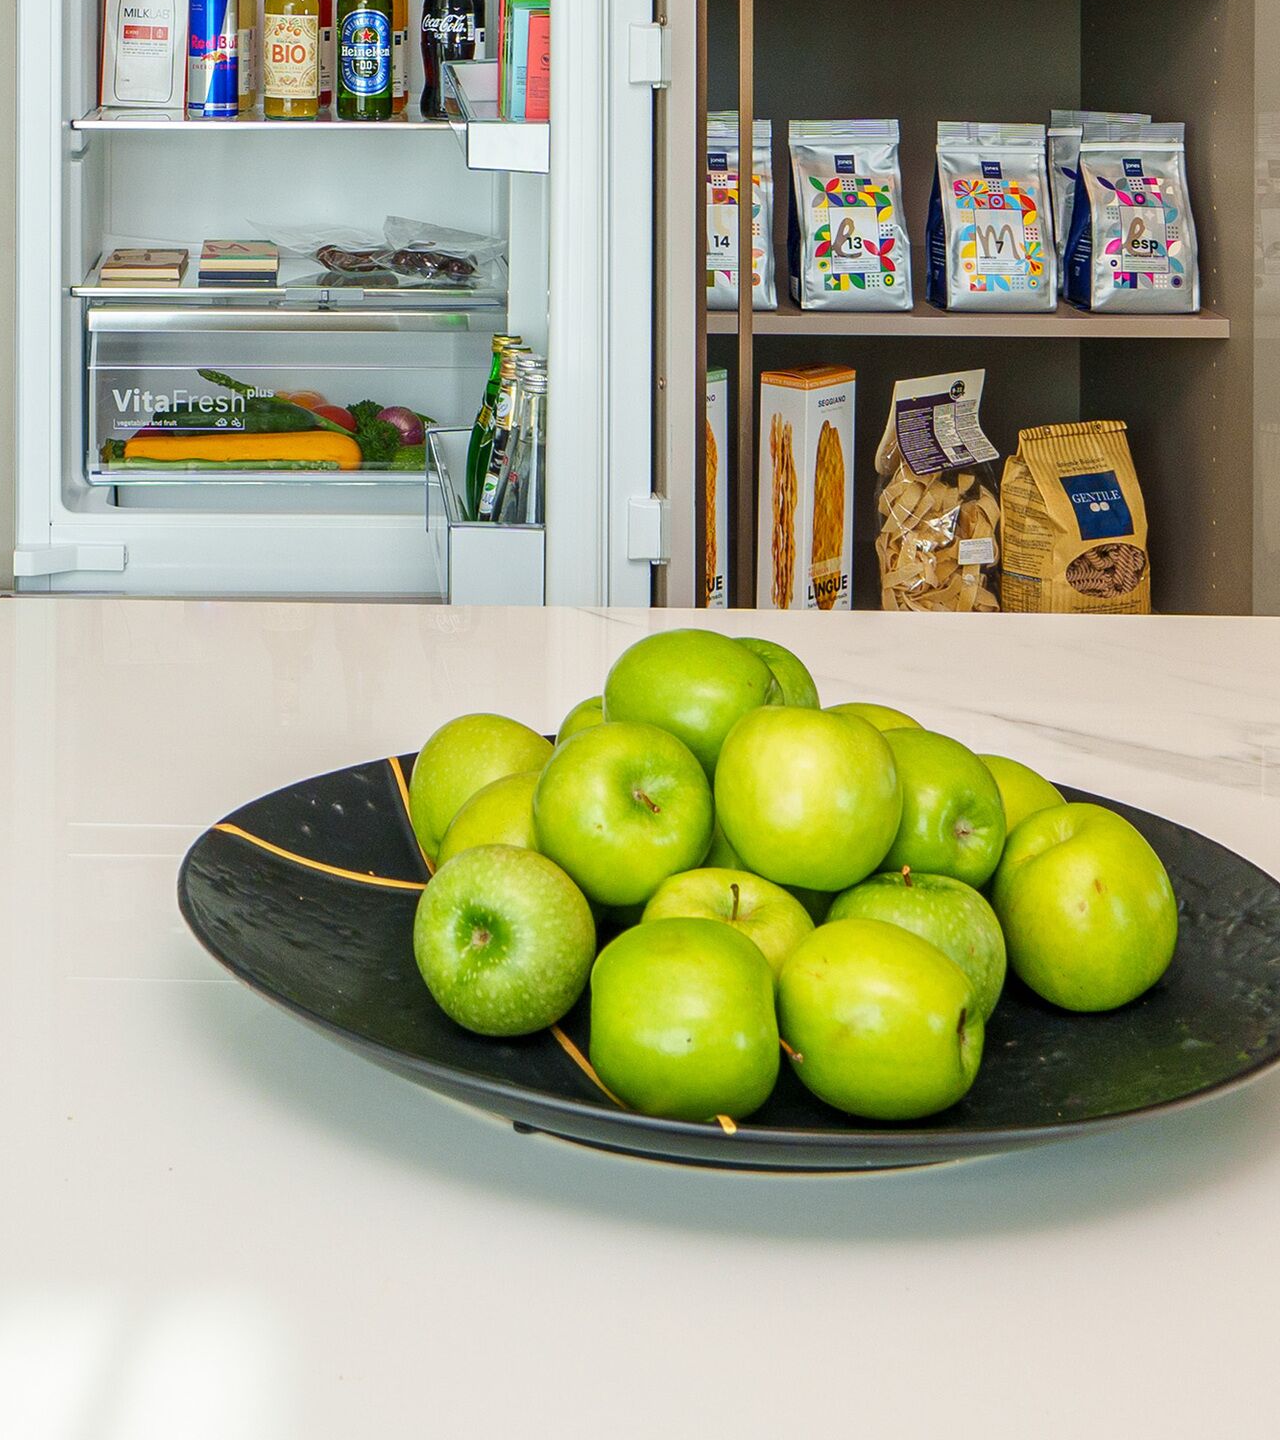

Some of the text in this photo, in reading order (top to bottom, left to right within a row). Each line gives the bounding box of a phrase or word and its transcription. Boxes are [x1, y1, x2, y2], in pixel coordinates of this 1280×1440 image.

[422, 14, 467, 33] Coca-Cola
[192, 34, 217, 49] Red
[272, 44, 306, 64] BIO
[341, 45, 390, 57] Heineken
[984, 164, 999, 172] jones
[1125, 161, 1140, 169] jones
[713, 235, 730, 248] 14
[847, 237, 862, 249] 13
[996, 241, 1004, 253] 7
[1131, 239, 1159, 254] esp
[112, 386, 274, 413] VitaFresh plus
[116, 419, 150, 427] vegetables
[1072, 490, 1121, 503] GENTILE
[808, 575, 848, 600] LINGUE
